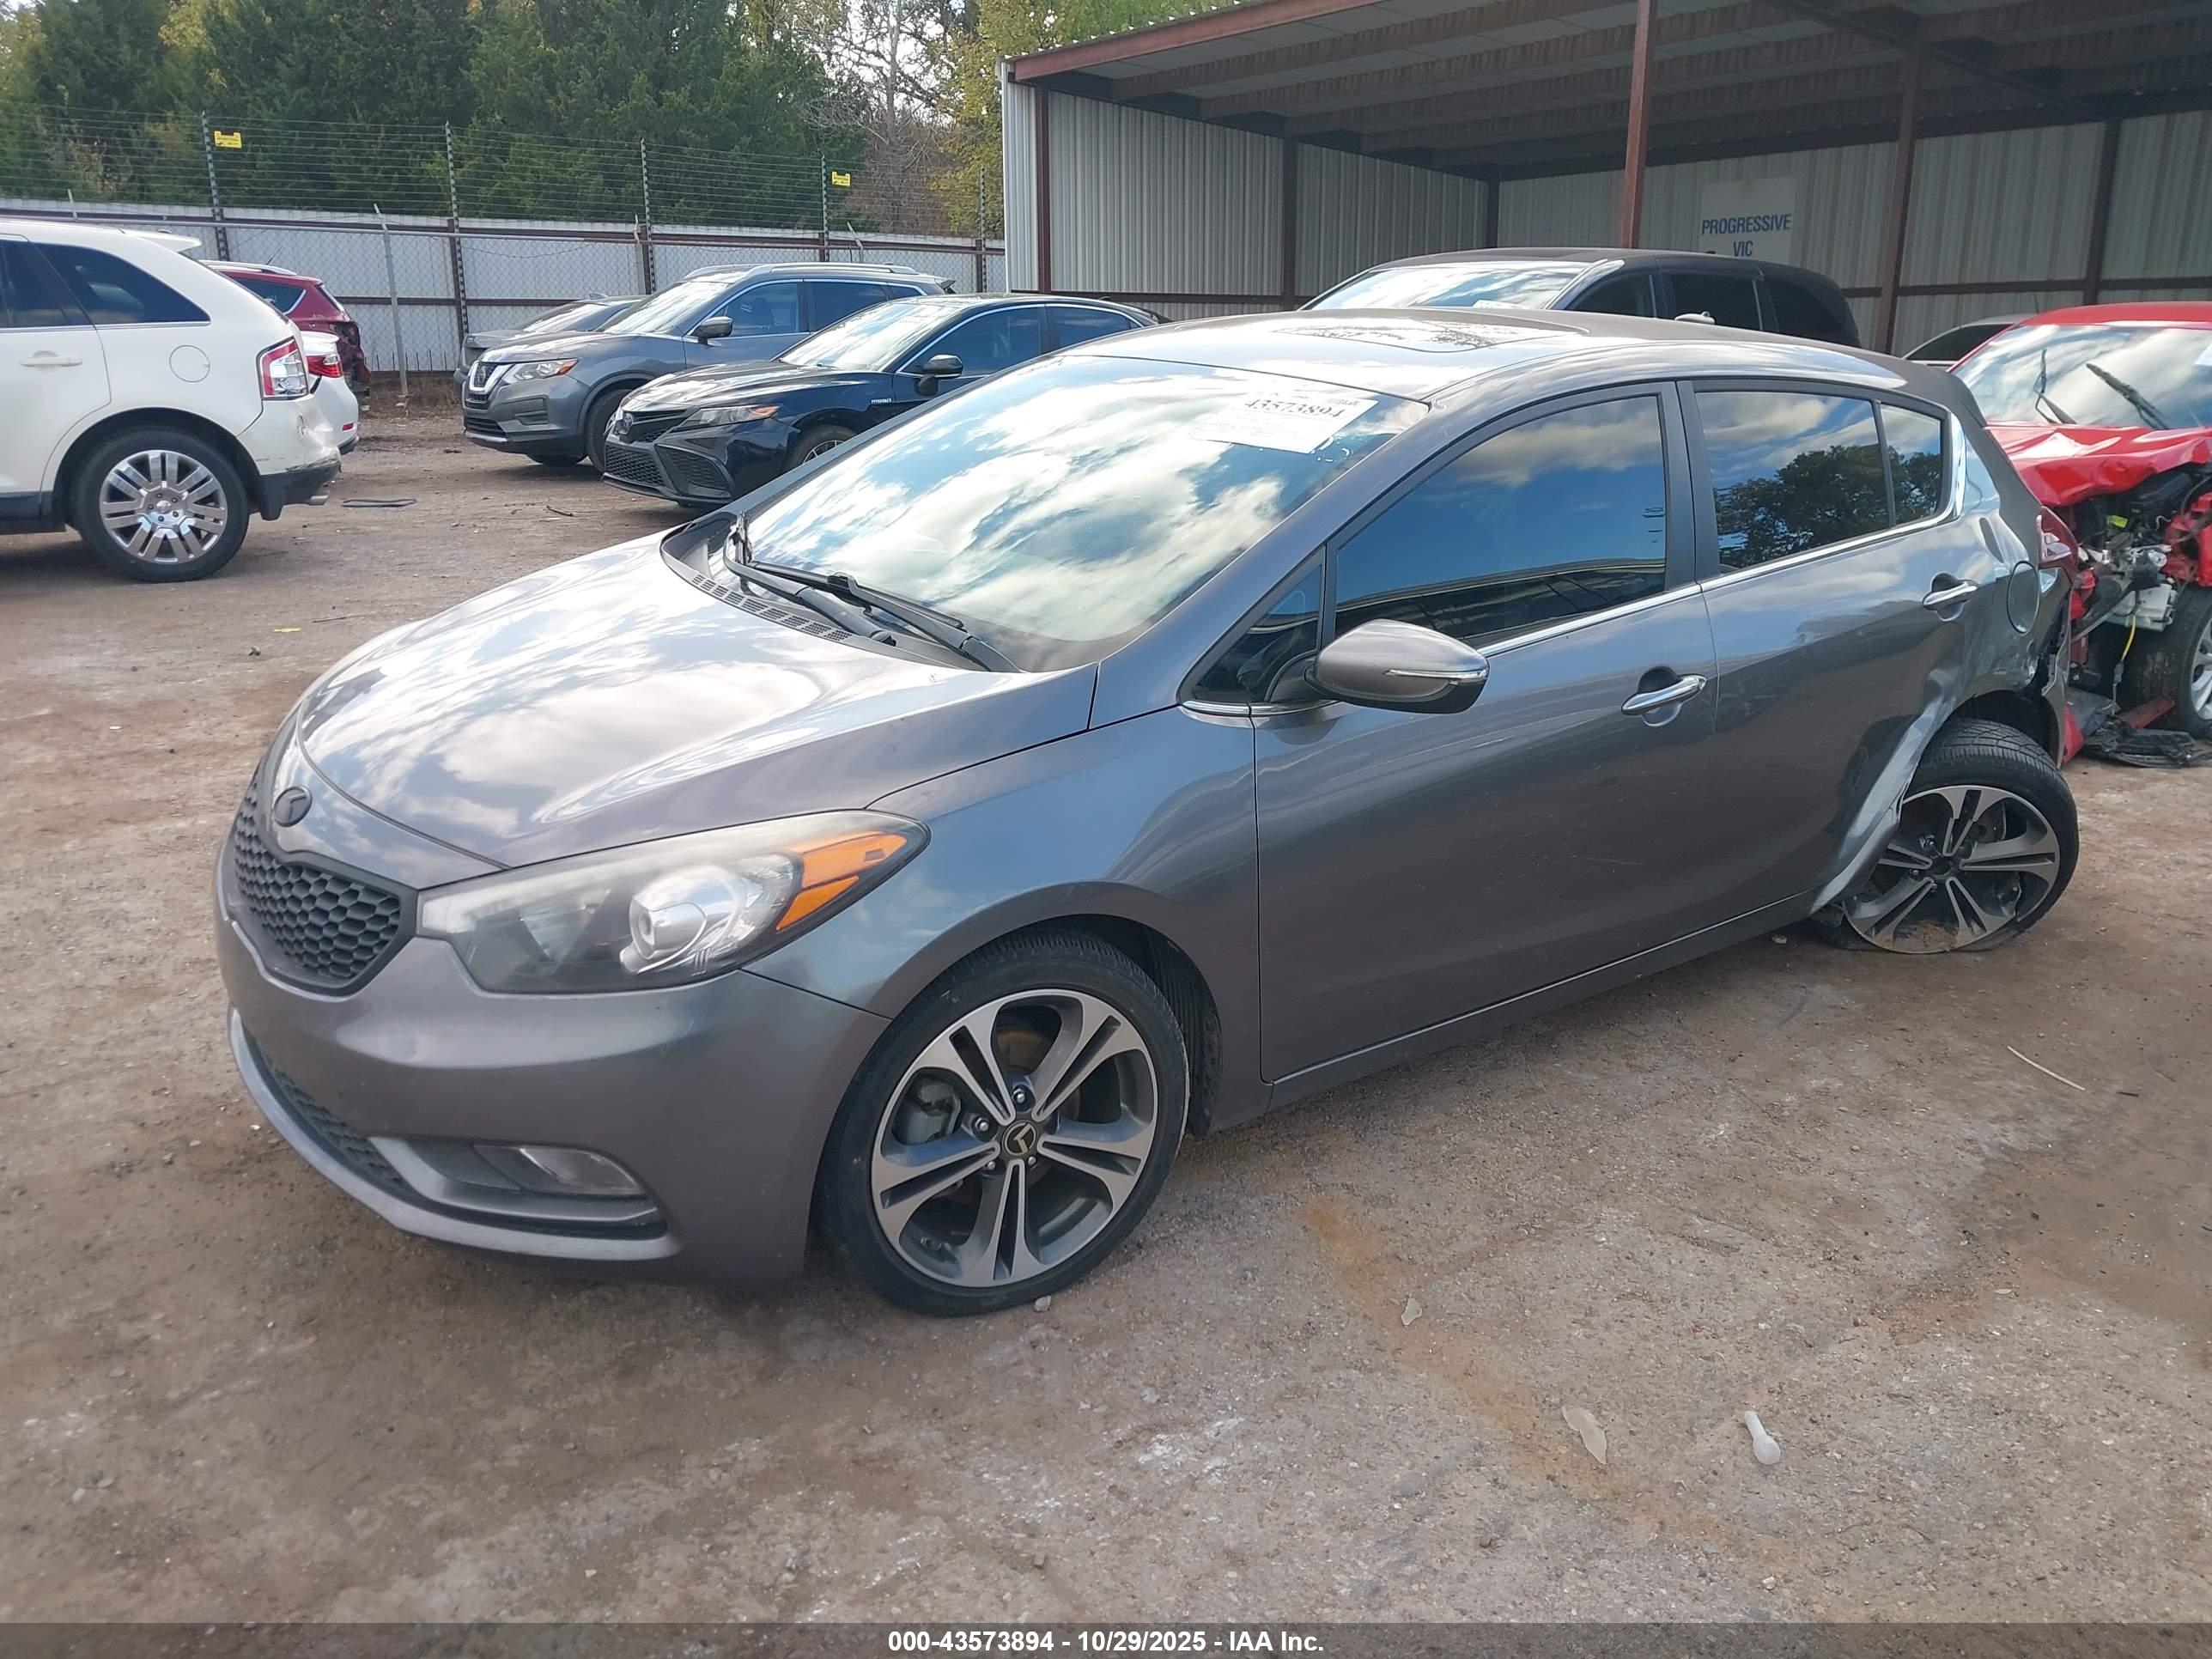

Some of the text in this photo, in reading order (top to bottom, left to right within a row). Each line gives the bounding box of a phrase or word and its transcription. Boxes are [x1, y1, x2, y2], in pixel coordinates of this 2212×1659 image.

[1702, 214, 1792, 235] PROGRESSIVE
[1733, 240, 1753, 257] VIC
[1244, 398, 1346, 418] 43573894
